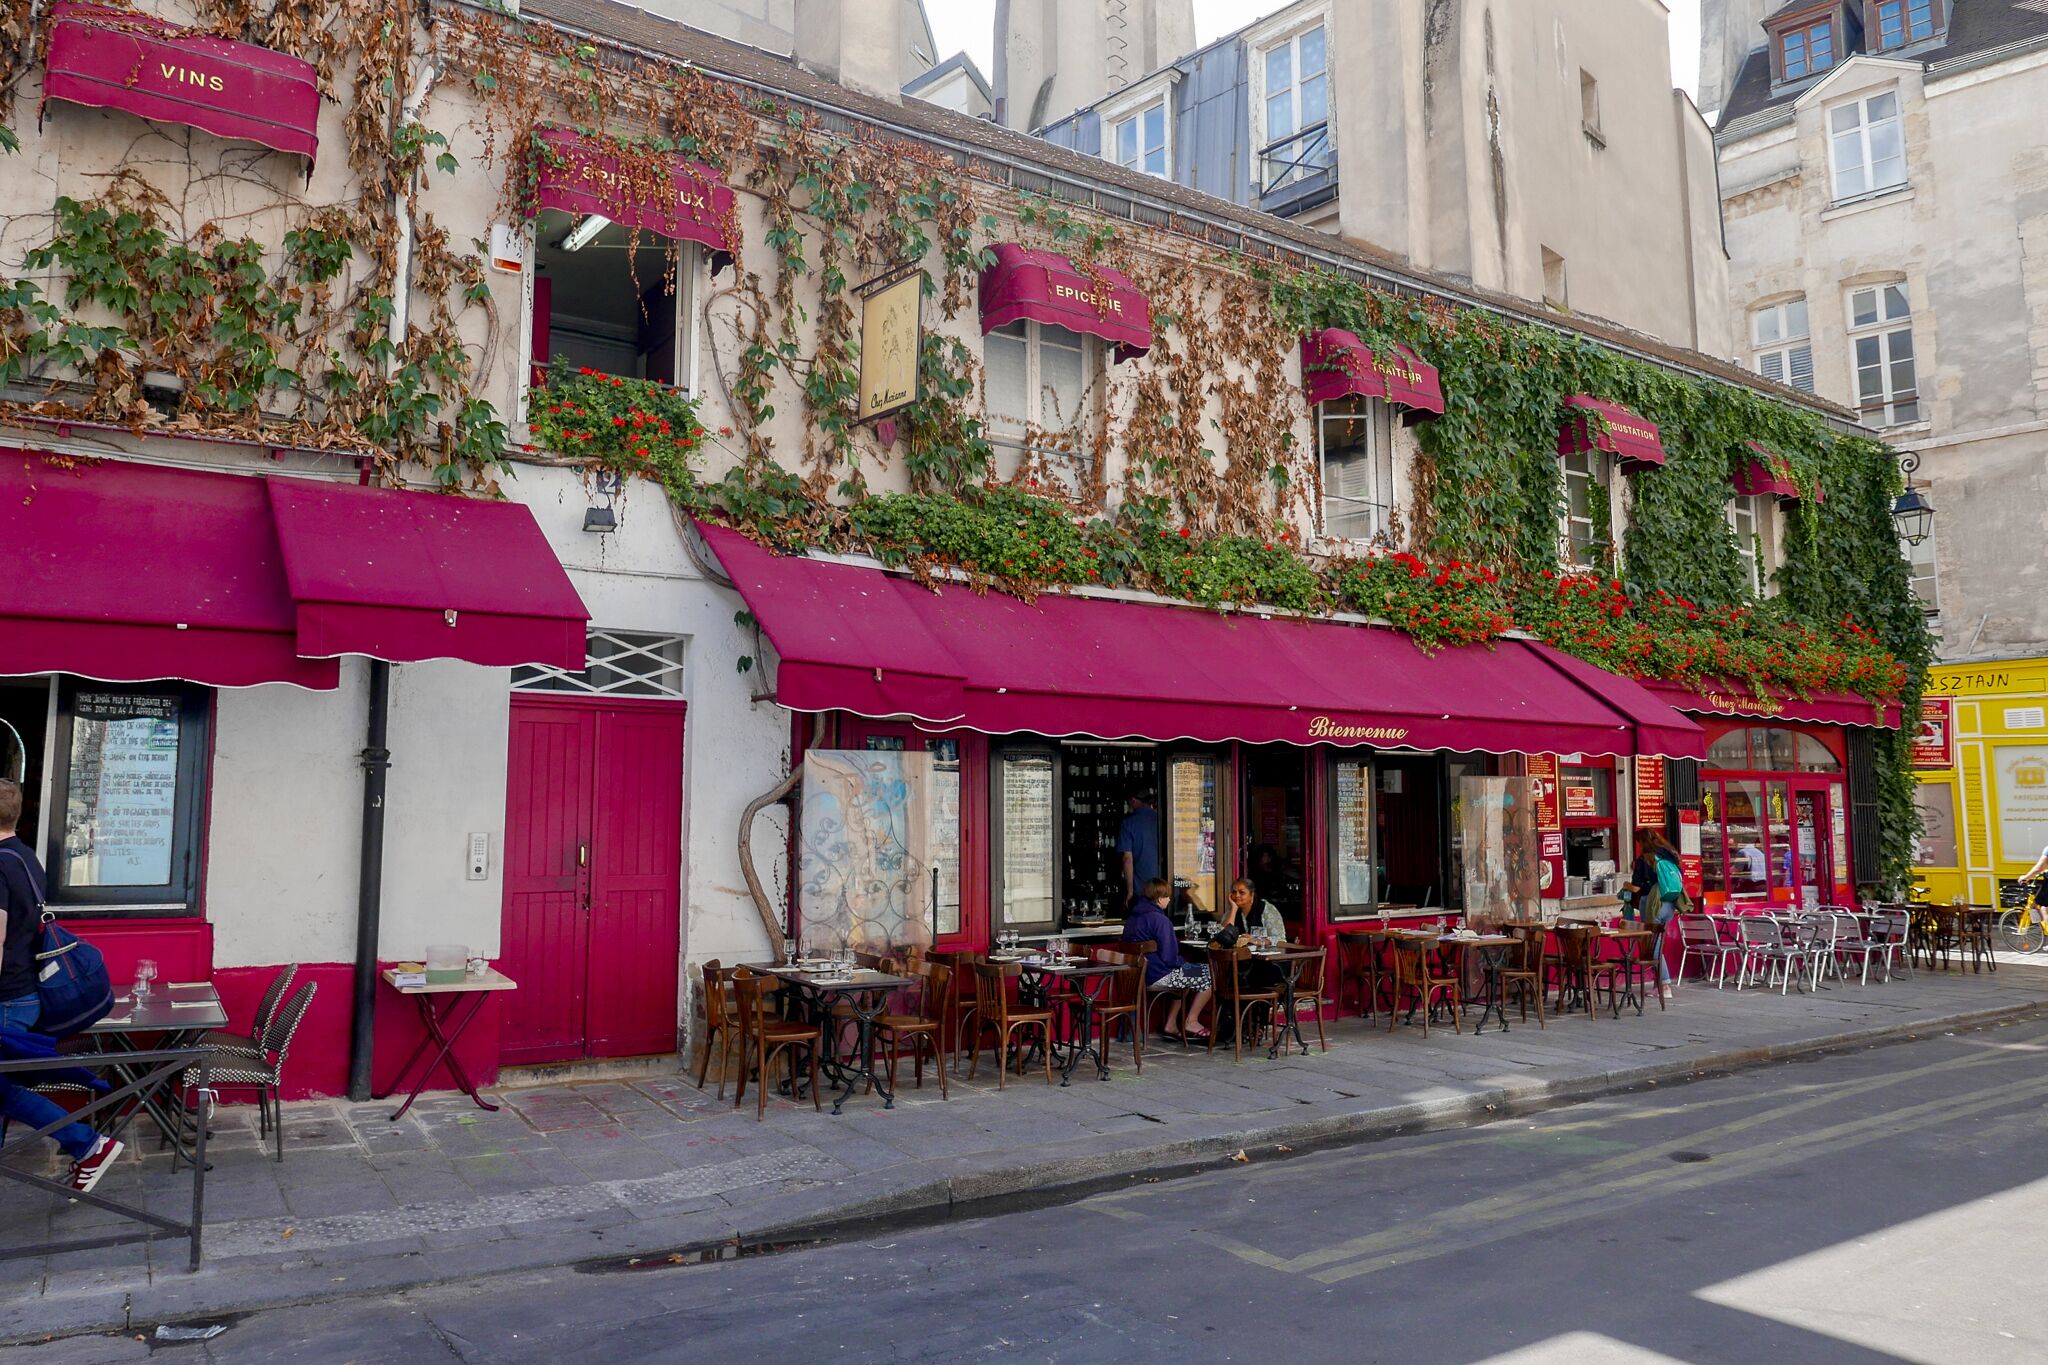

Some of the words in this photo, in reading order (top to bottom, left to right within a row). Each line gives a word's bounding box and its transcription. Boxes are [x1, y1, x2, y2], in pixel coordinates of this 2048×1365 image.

[161, 63, 224, 92] VINS
[582, 166, 705, 209] SPIREUX
[1605, 420, 1655, 441] EGUSTATION
[1931, 673, 2009, 691] LSZTAJN
[118, 706, 127, 714] AS
[1709, 693, 1735, 713] Chez
[1737, 696, 1785, 713] Mariane
[1308, 716, 1409, 739] Bienvenue
